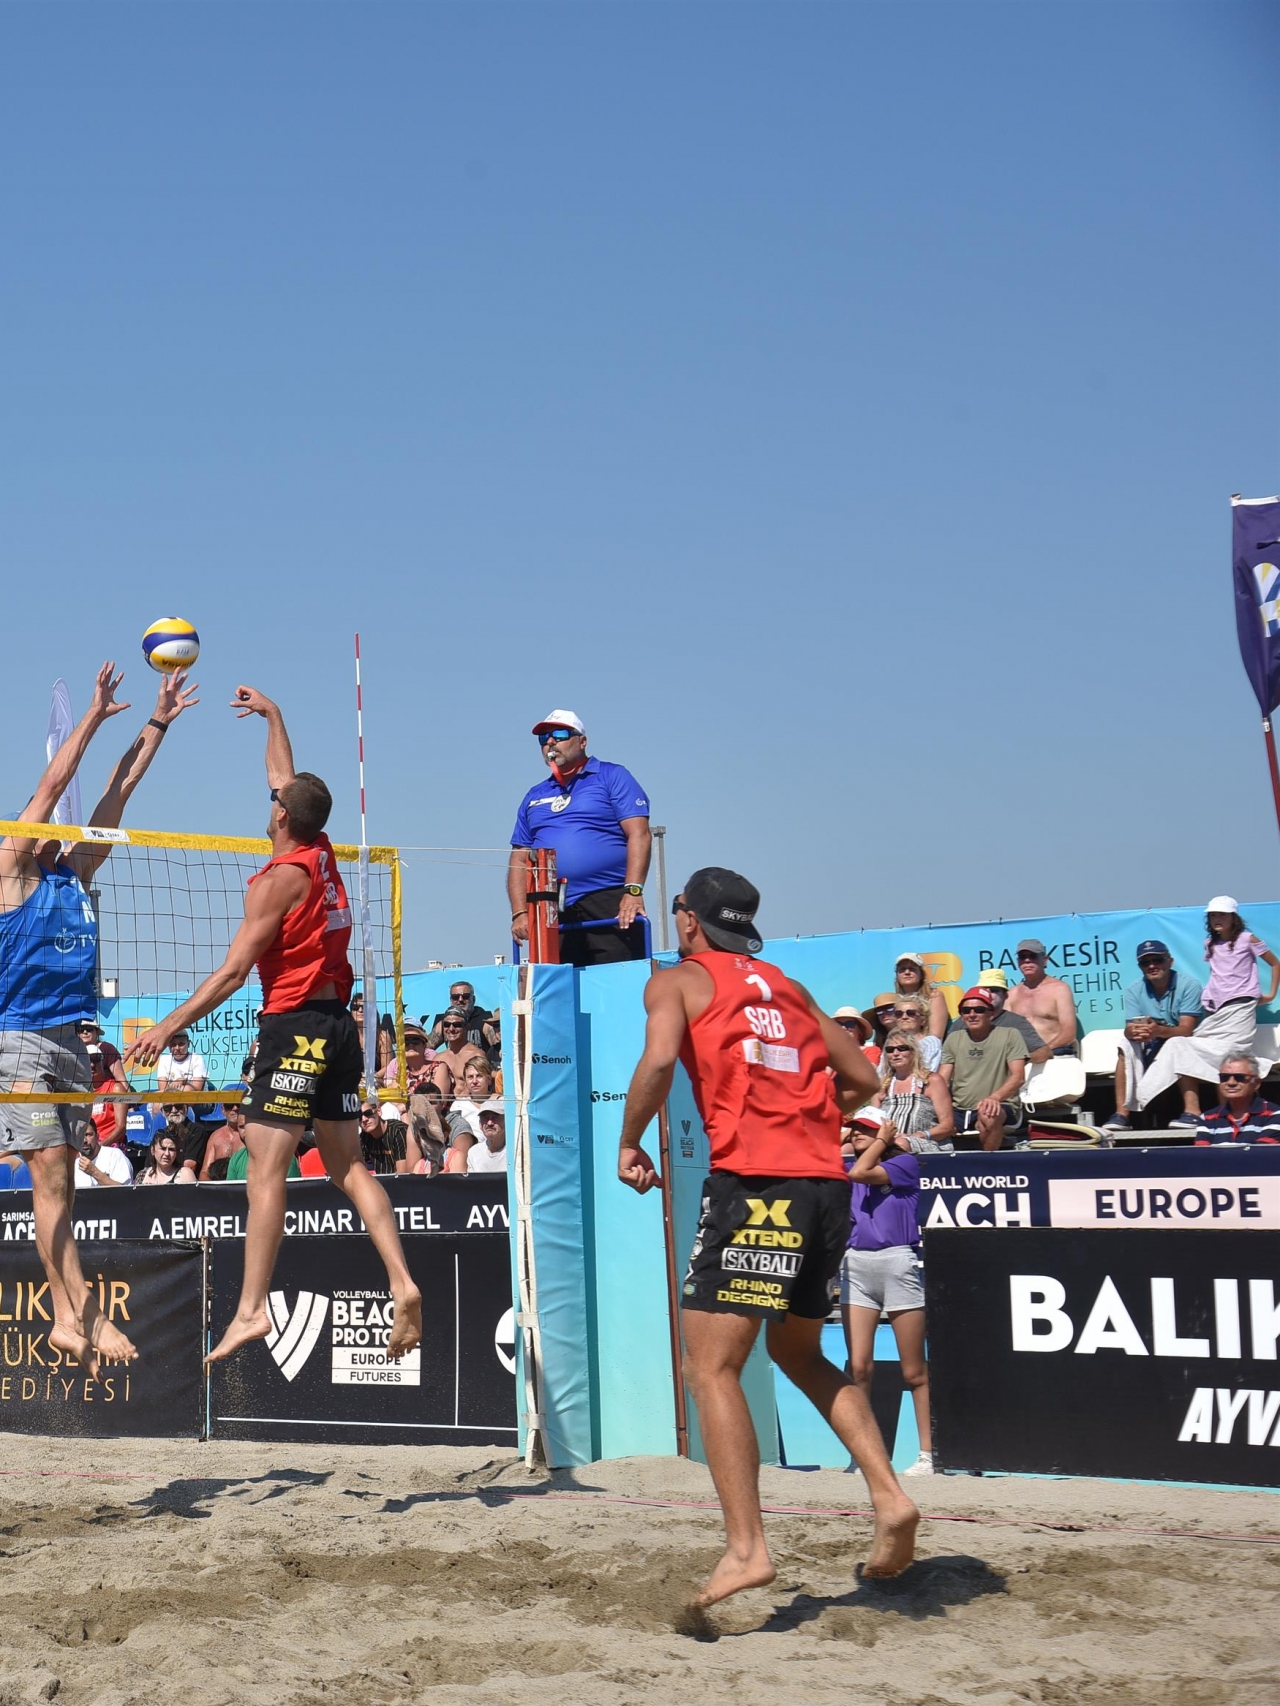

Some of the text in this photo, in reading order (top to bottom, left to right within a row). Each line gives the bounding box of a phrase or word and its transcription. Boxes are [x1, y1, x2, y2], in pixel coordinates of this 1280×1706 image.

[319, 851, 329, 880] 2
[979, 935, 1121, 972] BAKESİR
[744, 974, 772, 1001] 1
[744, 1006, 786, 1039] SRB
[541, 1055, 572, 1064] Senoh
[602, 1092, 628, 1101] Sen
[263, 1103, 311, 1118] DESIGNS
[6, 1128, 15, 1142] 2
[964, 1175, 1029, 1189] WORLD
[1095, 1187, 1262, 1219] EUROPE
[1, 1211, 36, 1222] SARIMSA
[149, 1206, 441, 1240] A.EMREL ÇINAR TEL
[71, 1219, 117, 1240] OTEL
[730, 1229, 803, 1248] XTEND
[727, 1251, 798, 1275] SKYBALL
[333, 1291, 387, 1299] VOLLEYBALL
[730, 1278, 782, 1295] RHINO
[717, 1290, 790, 1310] DESIGNS
[332, 1300, 395, 1326] BEAC
[332, 1327, 370, 1345] PRO
[351, 1353, 401, 1366] EUROPE
[350, 1371, 401, 1382] FUTURES
[1177, 1387, 1280, 1447] AYV
